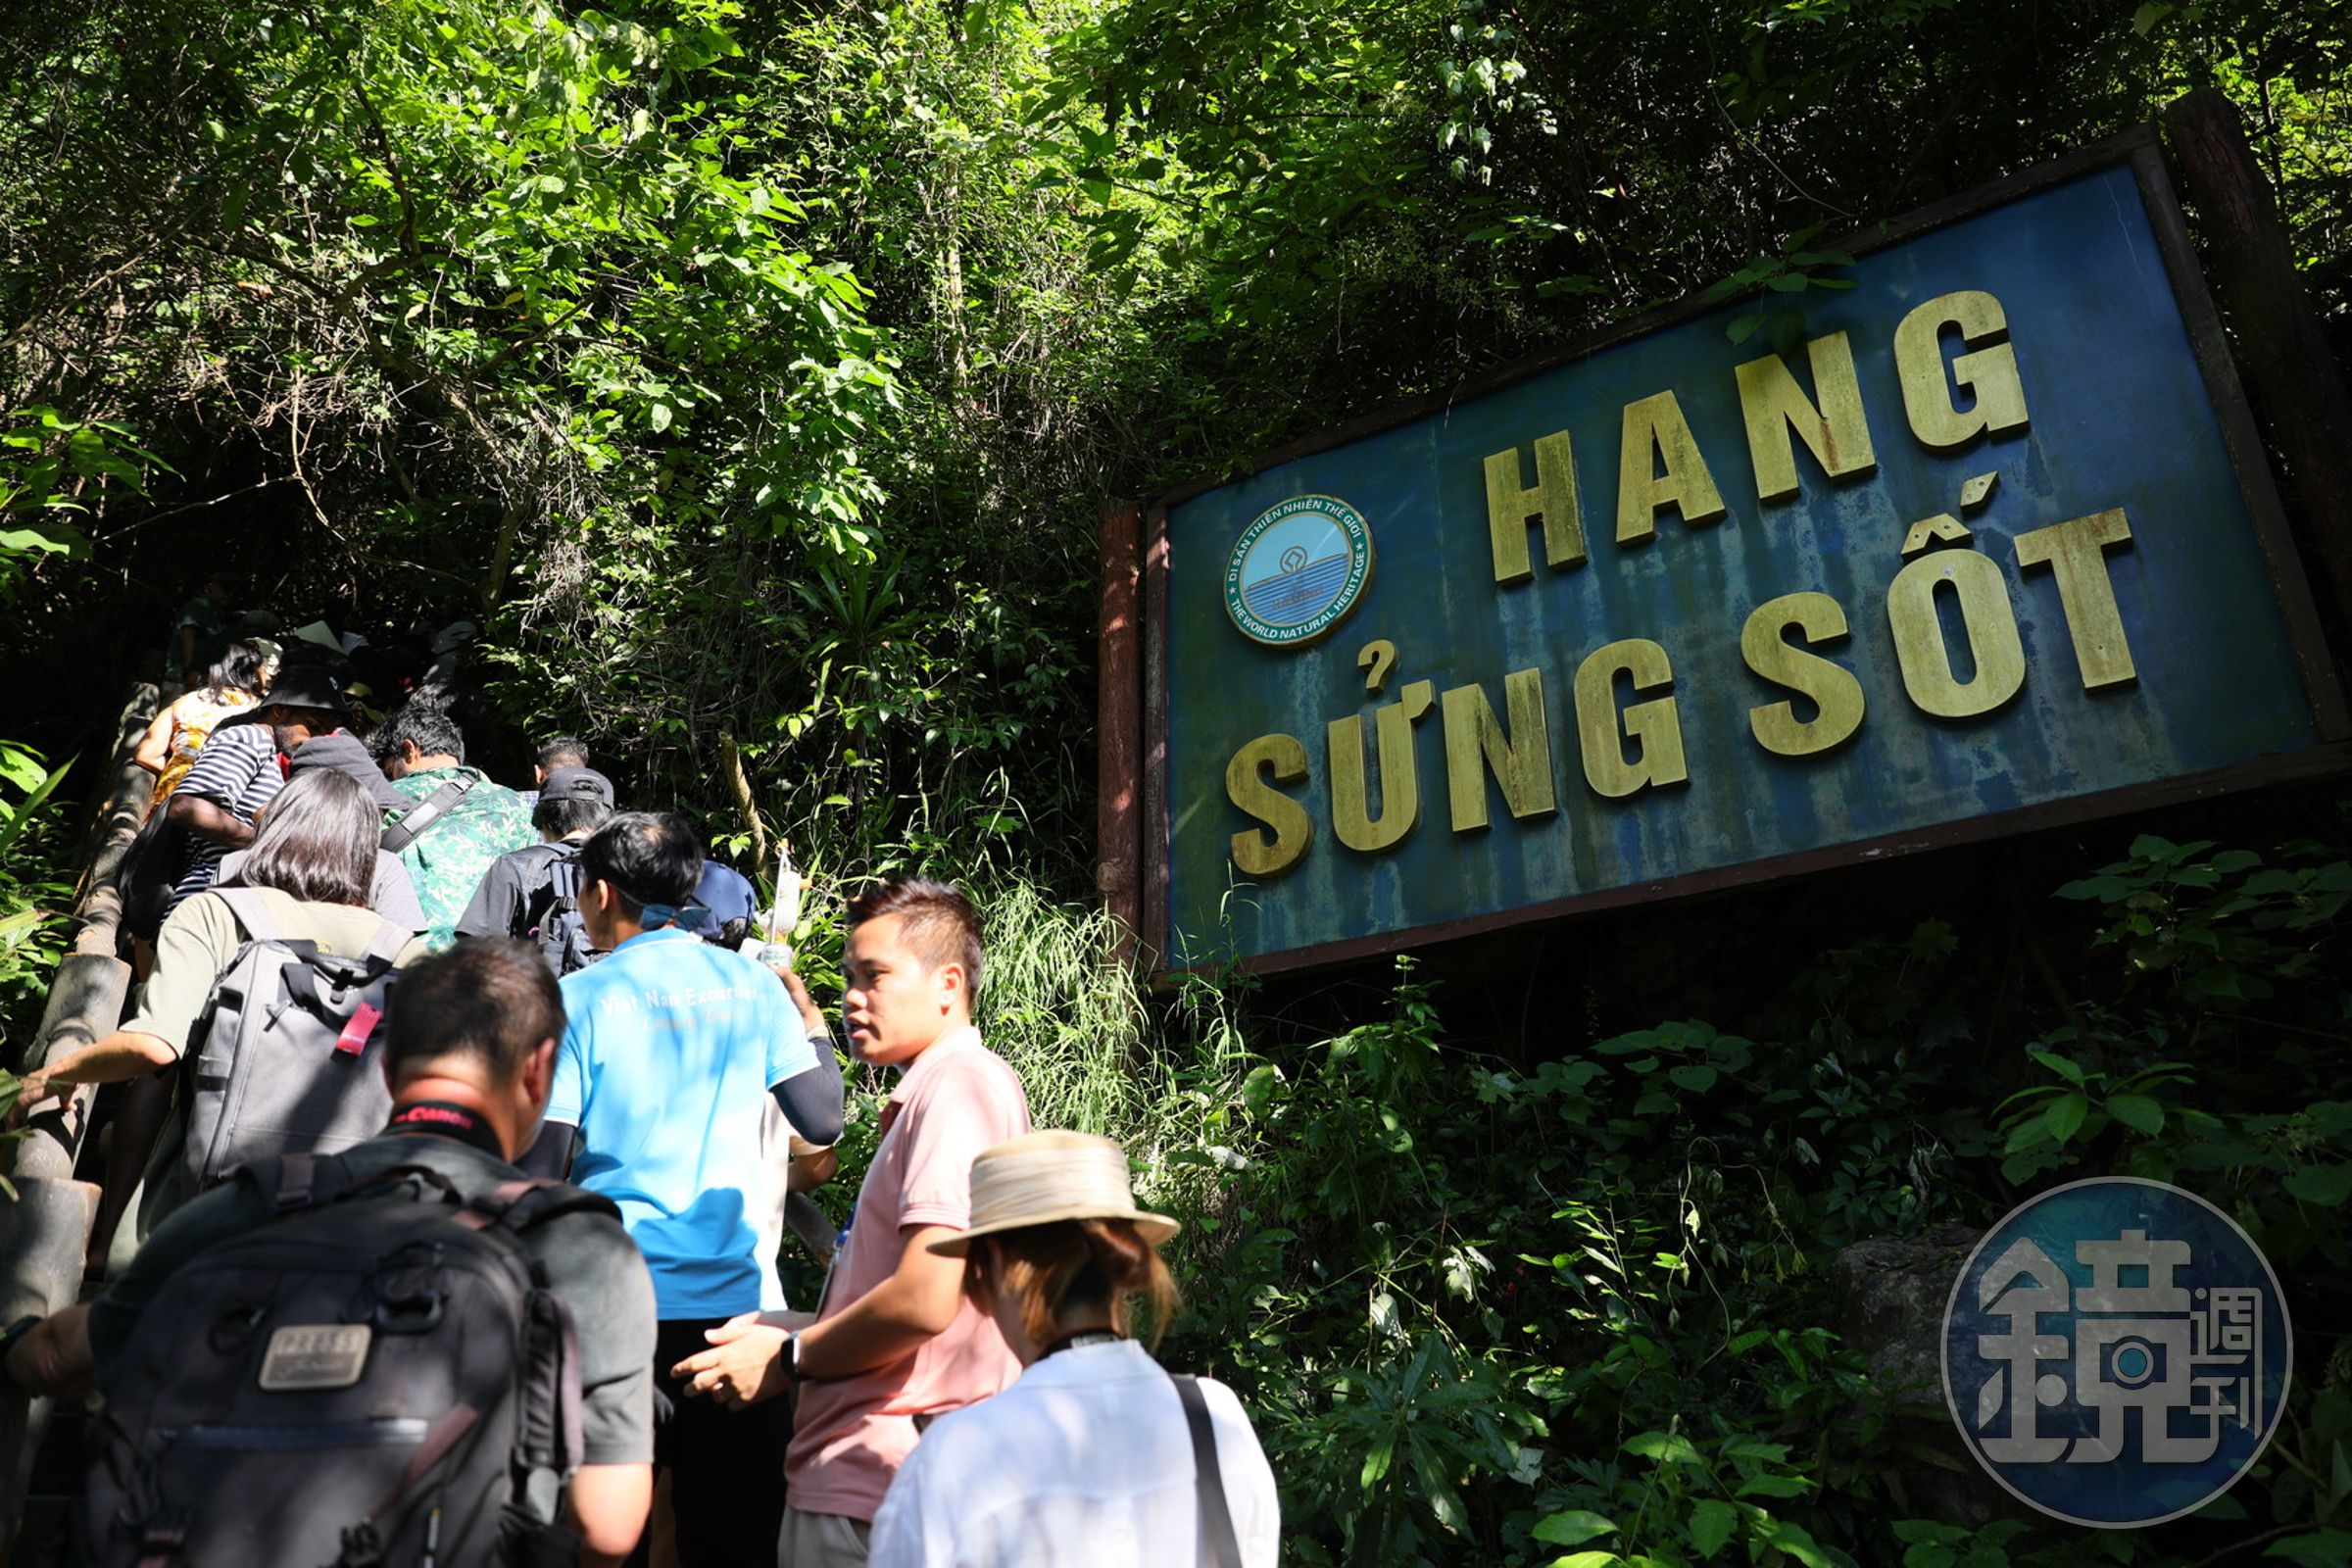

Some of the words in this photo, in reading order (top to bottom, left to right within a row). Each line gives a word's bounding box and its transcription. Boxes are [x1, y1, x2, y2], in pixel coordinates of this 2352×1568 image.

[1484, 290, 2031, 583] HANG
[1229, 568, 1238, 581] DI
[1283, 498, 1322, 514] NHIÊN
[1231, 599, 1247, 619] THE
[1244, 614, 1278, 638] WORLD
[1280, 611, 1336, 639] NATURAL
[1334, 551, 1365, 612] HERITAGE
[1226, 640, 1690, 878] SỬNG
[1740, 470, 2137, 757] SỐT
